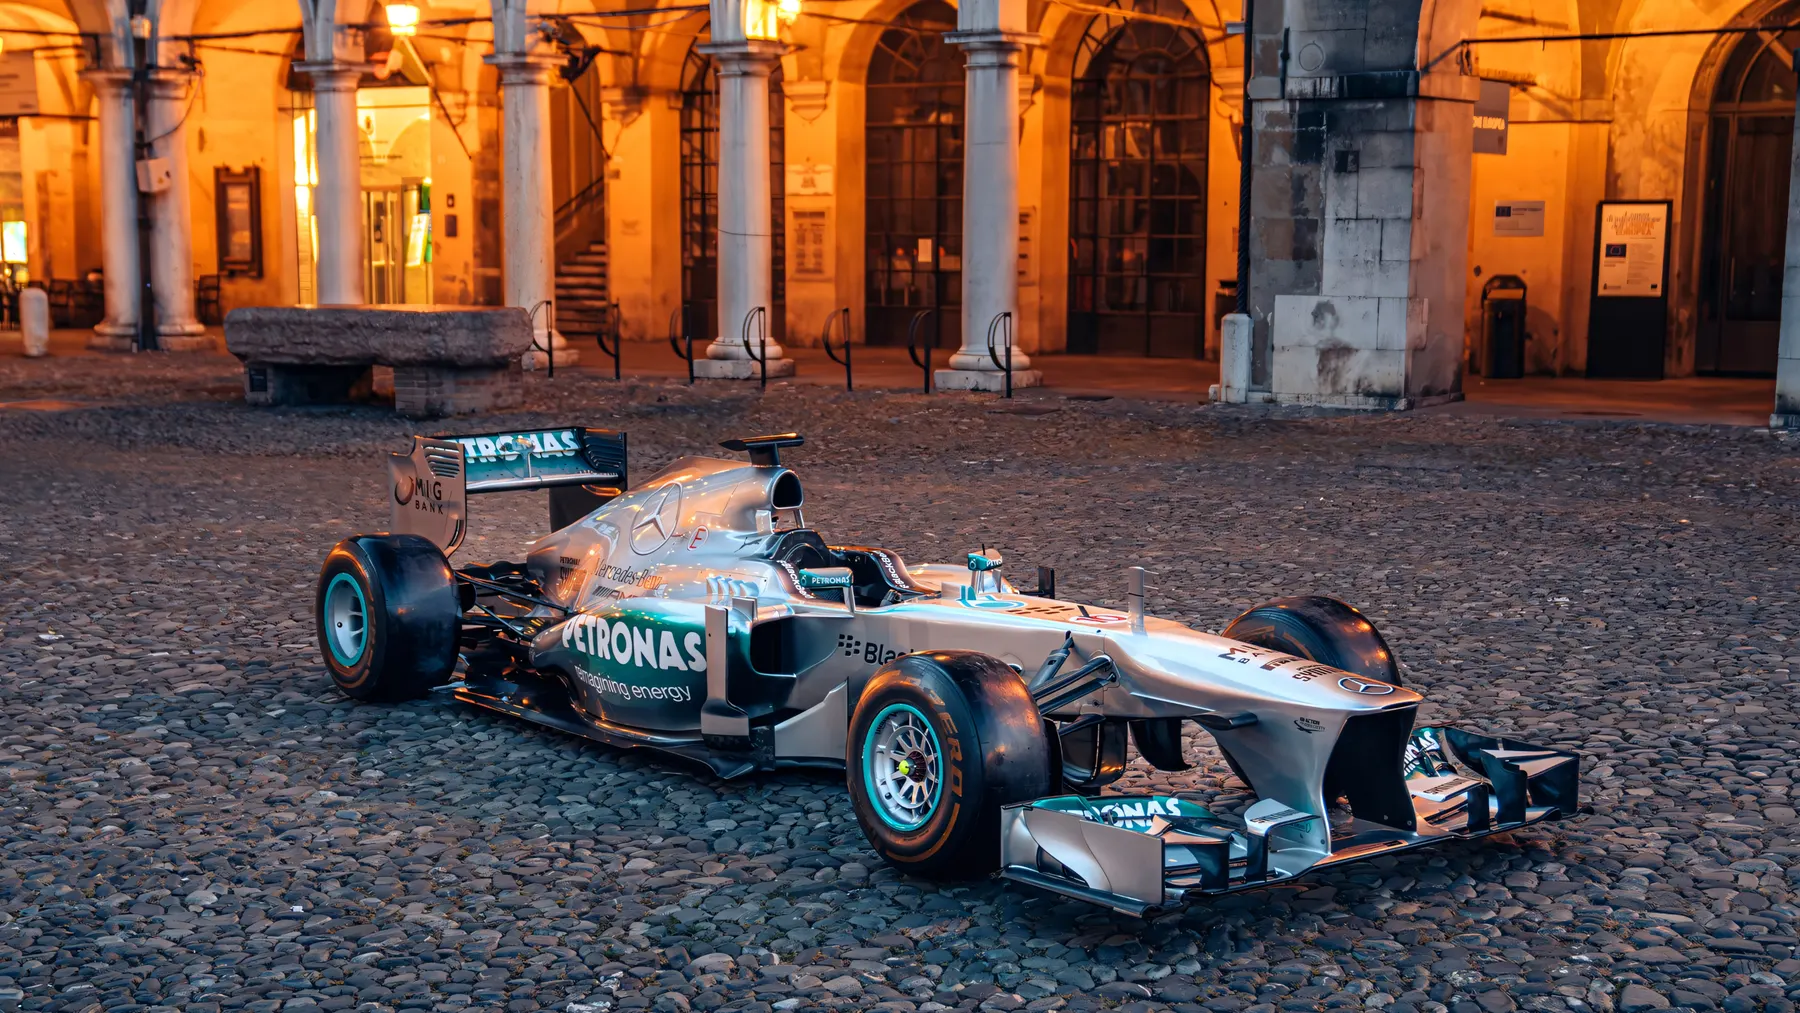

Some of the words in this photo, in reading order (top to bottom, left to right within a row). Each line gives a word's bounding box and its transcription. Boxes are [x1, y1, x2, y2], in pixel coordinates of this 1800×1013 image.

[415, 500, 444, 515] BANK
[689, 527, 707, 549] E
[594, 558, 665, 591] Mercedes-Benz
[811, 575, 850, 585] PETRONAS
[562, 613, 708, 673] PETRONAS
[864, 642, 914, 666] Bla
[574, 664, 631, 700] reimagining
[631, 684, 692, 702] energy
